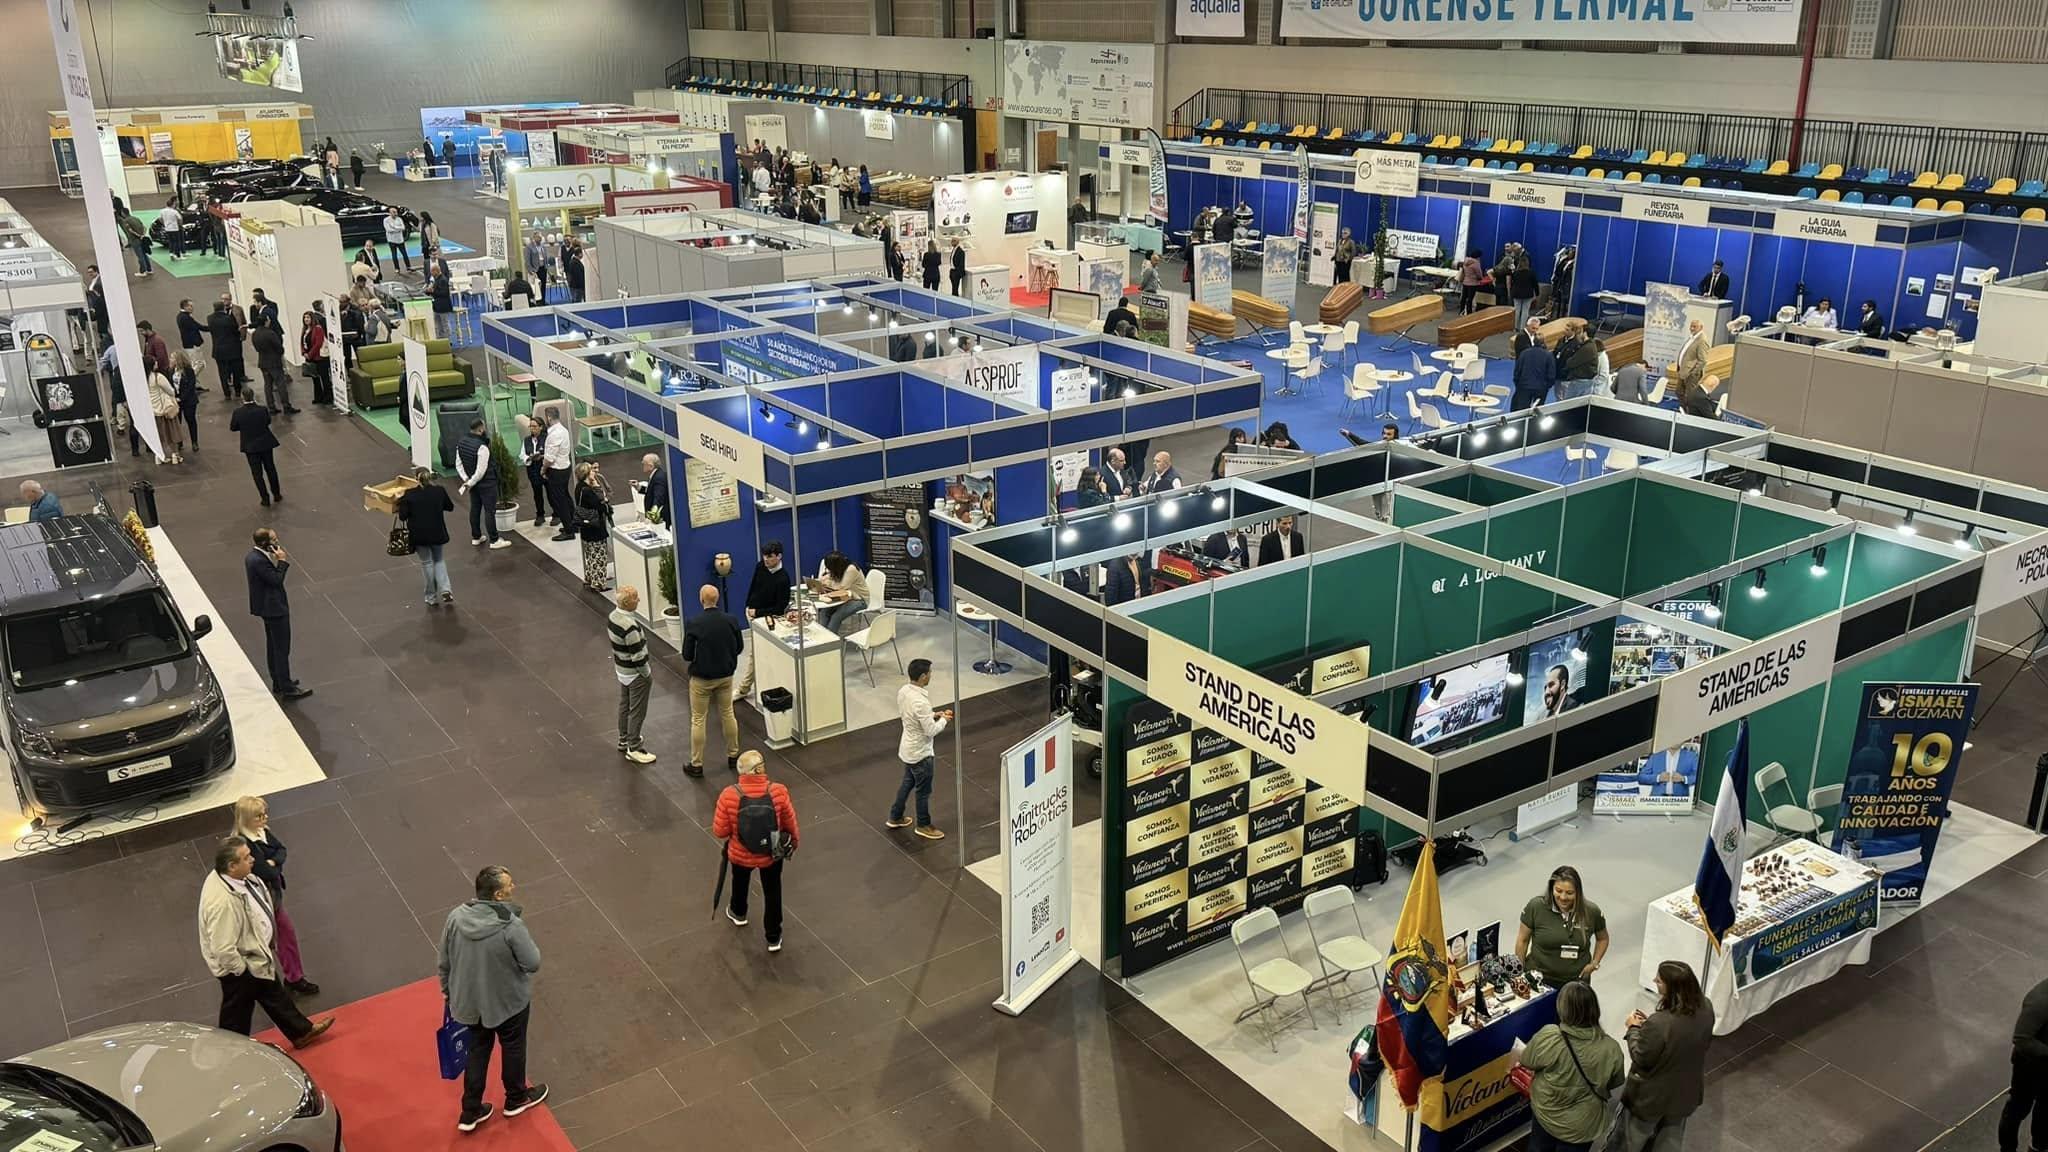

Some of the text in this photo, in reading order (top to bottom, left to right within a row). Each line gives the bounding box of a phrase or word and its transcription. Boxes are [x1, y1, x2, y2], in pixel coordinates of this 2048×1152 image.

[1392, 158, 1417, 169] METAL
[534, 184, 586, 200] CIDAF
[1518, 187, 1535, 195] MUZI
[1507, 194, 1546, 205] UNIFORMES
[1650, 201, 1680, 212] REVISTA
[1643, 209, 1685, 220] FUNERARIA
[1808, 217, 1841, 228] LA GUIA
[1800, 225, 1847, 238] FUNERARIA
[1416, 236, 1436, 246] METAL
[549, 360, 573, 381] ATROESA
[699, 432, 739, 462] SEGI HIRU
[1322, 666, 1361, 682] CONFIANZA
[1330, 660, 1354, 672] SOMOS
[1698, 639, 1807, 698] STAND DE LAS
[1185, 661, 1316, 741] STAND DE LAS
[1898, 695, 1966, 709] ISMAEL
[1146, 742, 1174, 756] SOMOS
[1891, 731, 1953, 778] 10
[1141, 749, 1179, 766] ECUADOR
[1207, 762, 1235, 774] YO SOY
[1202, 769, 1240, 785] VIDANOVA
[1266, 772, 1292, 785] SOMOS
[1887, 775, 1938, 791] AÑOS
[1262, 778, 1296, 794] ECUADOR
[1848, 795, 1922, 804] TRABAJANDO
[1011, 785, 1067, 834] Minitrucks
[1851, 804, 1919, 817] CALIDAD
[1146, 817, 1173, 832] SOMOS
[1840, 812, 1939, 829] INNOVACIÓN
[1137, 823, 1180, 842] CONFIANZA
[1202, 825, 1237, 842] TU MEJOR
[1199, 832, 1239, 850] ASISTENCIA
[1264, 841, 1288, 854] SOMOS
[1256, 846, 1294, 864] CONFIANZA
[1324, 848, 1345, 860] MEJOR
[1311, 854, 1347, 872] ASISTENCIA
[1144, 884, 1171, 899] SOMOS
[1205, 888, 1231, 903] SOMOS
[1134, 889, 1181, 912] EXPERIENCIA
[1201, 895, 1235, 912] ECUADOR
[1758, 913, 1818, 949] FUNERALES
[1771, 929, 1810, 957] ISMAEL
